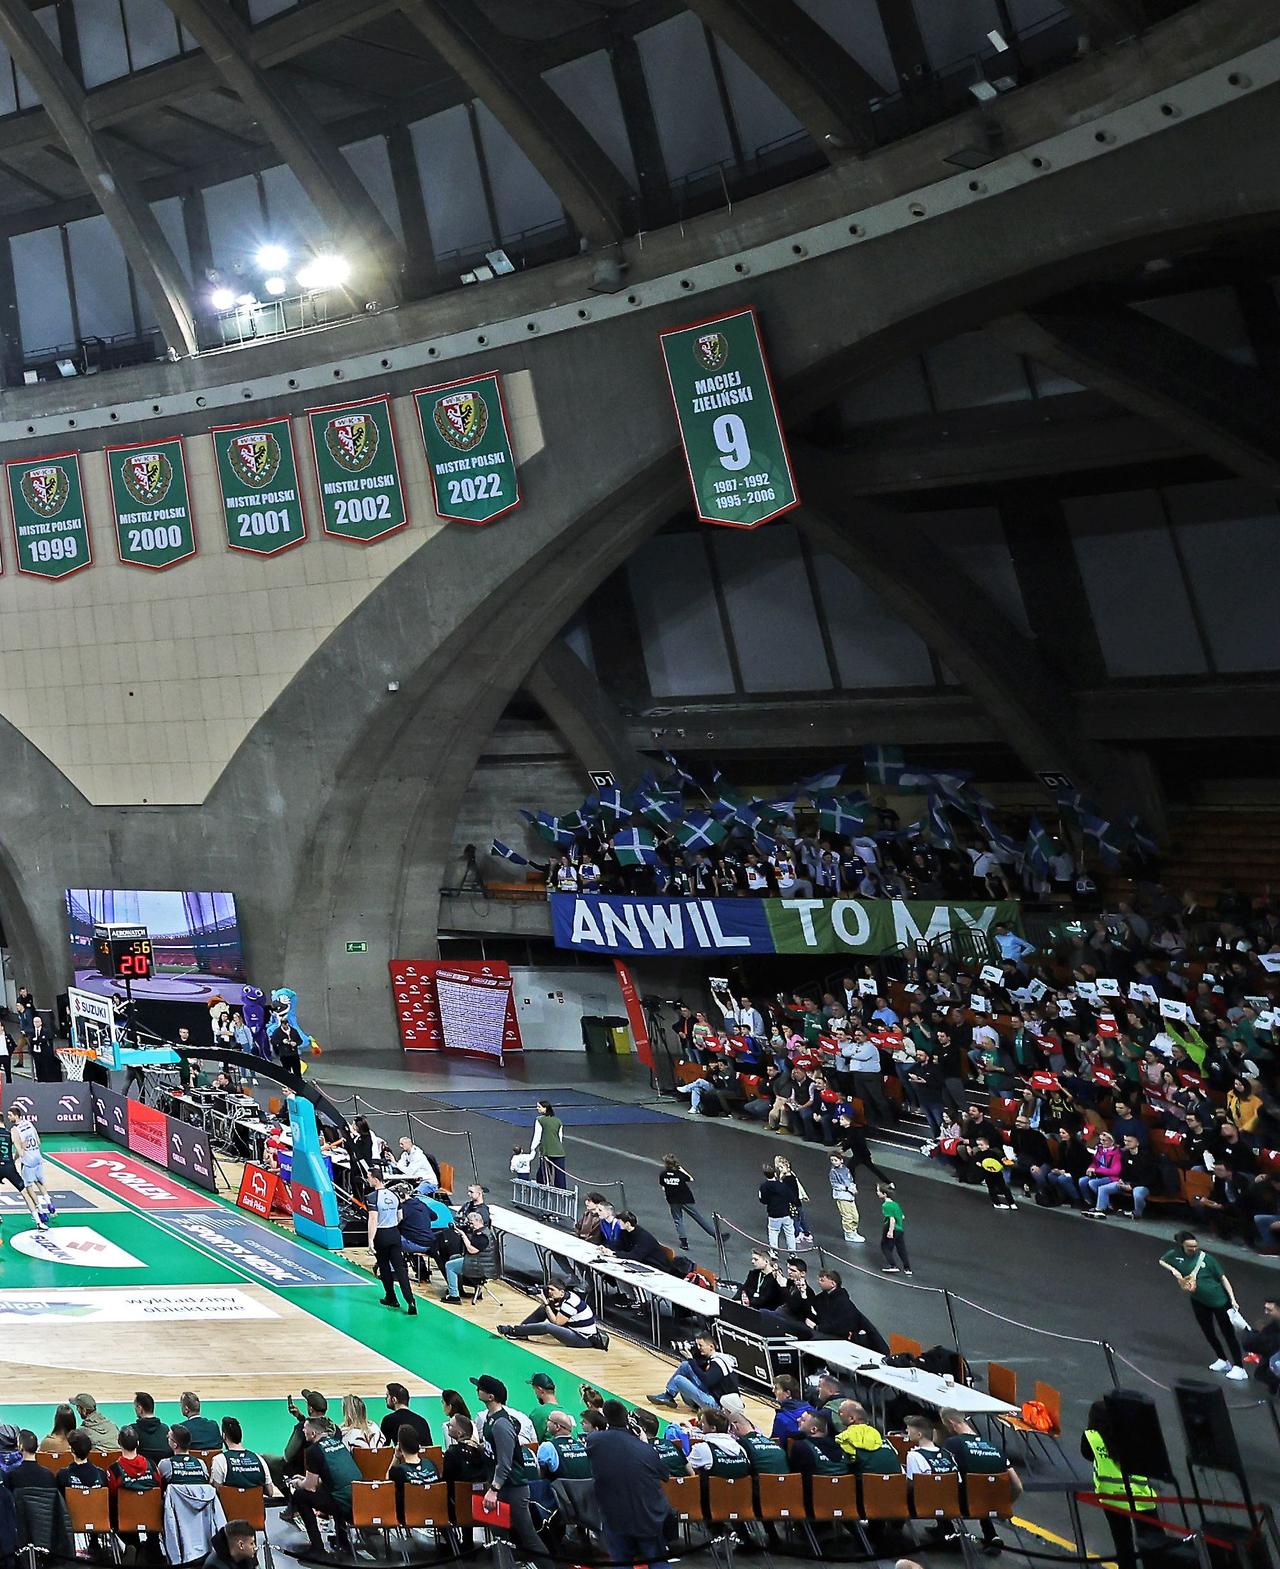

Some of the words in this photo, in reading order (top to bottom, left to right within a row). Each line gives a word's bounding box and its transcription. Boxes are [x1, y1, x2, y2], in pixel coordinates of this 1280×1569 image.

[695, 371, 741, 395] MACIEJ
[692, 386, 753, 414] ZIELIŃSKI
[713, 413, 751, 471] 9
[436, 460, 471, 474] MISTRZ
[471, 452, 505, 468] POLSKI
[324, 480, 360, 494] MISTRZ
[360, 474, 394, 490] POLSKI
[447, 473, 503, 504] 2022
[226, 494, 261, 508] MISTRZ
[262, 490, 295, 504] POLSKI
[335, 494, 391, 524] 2002
[19, 524, 51, 536] MISTRZ
[51, 519, 82, 533] POLSKI
[120, 512, 153, 524] MISTRZ
[153, 507, 186, 521] POLSKI
[238, 509, 291, 537] 2001
[28, 537, 78, 562] 1999
[128, 525, 182, 552] 2000
[593, 775, 614, 786] D1
[571, 899, 751, 949] ANWIL
[781, 899, 871, 946] TO
[893, 899, 997, 952] MY
[119, 956, 148, 974] 20
[81, 1001, 107, 1021] SUZUKI
[115, 1171, 178, 1200] ORLEN
